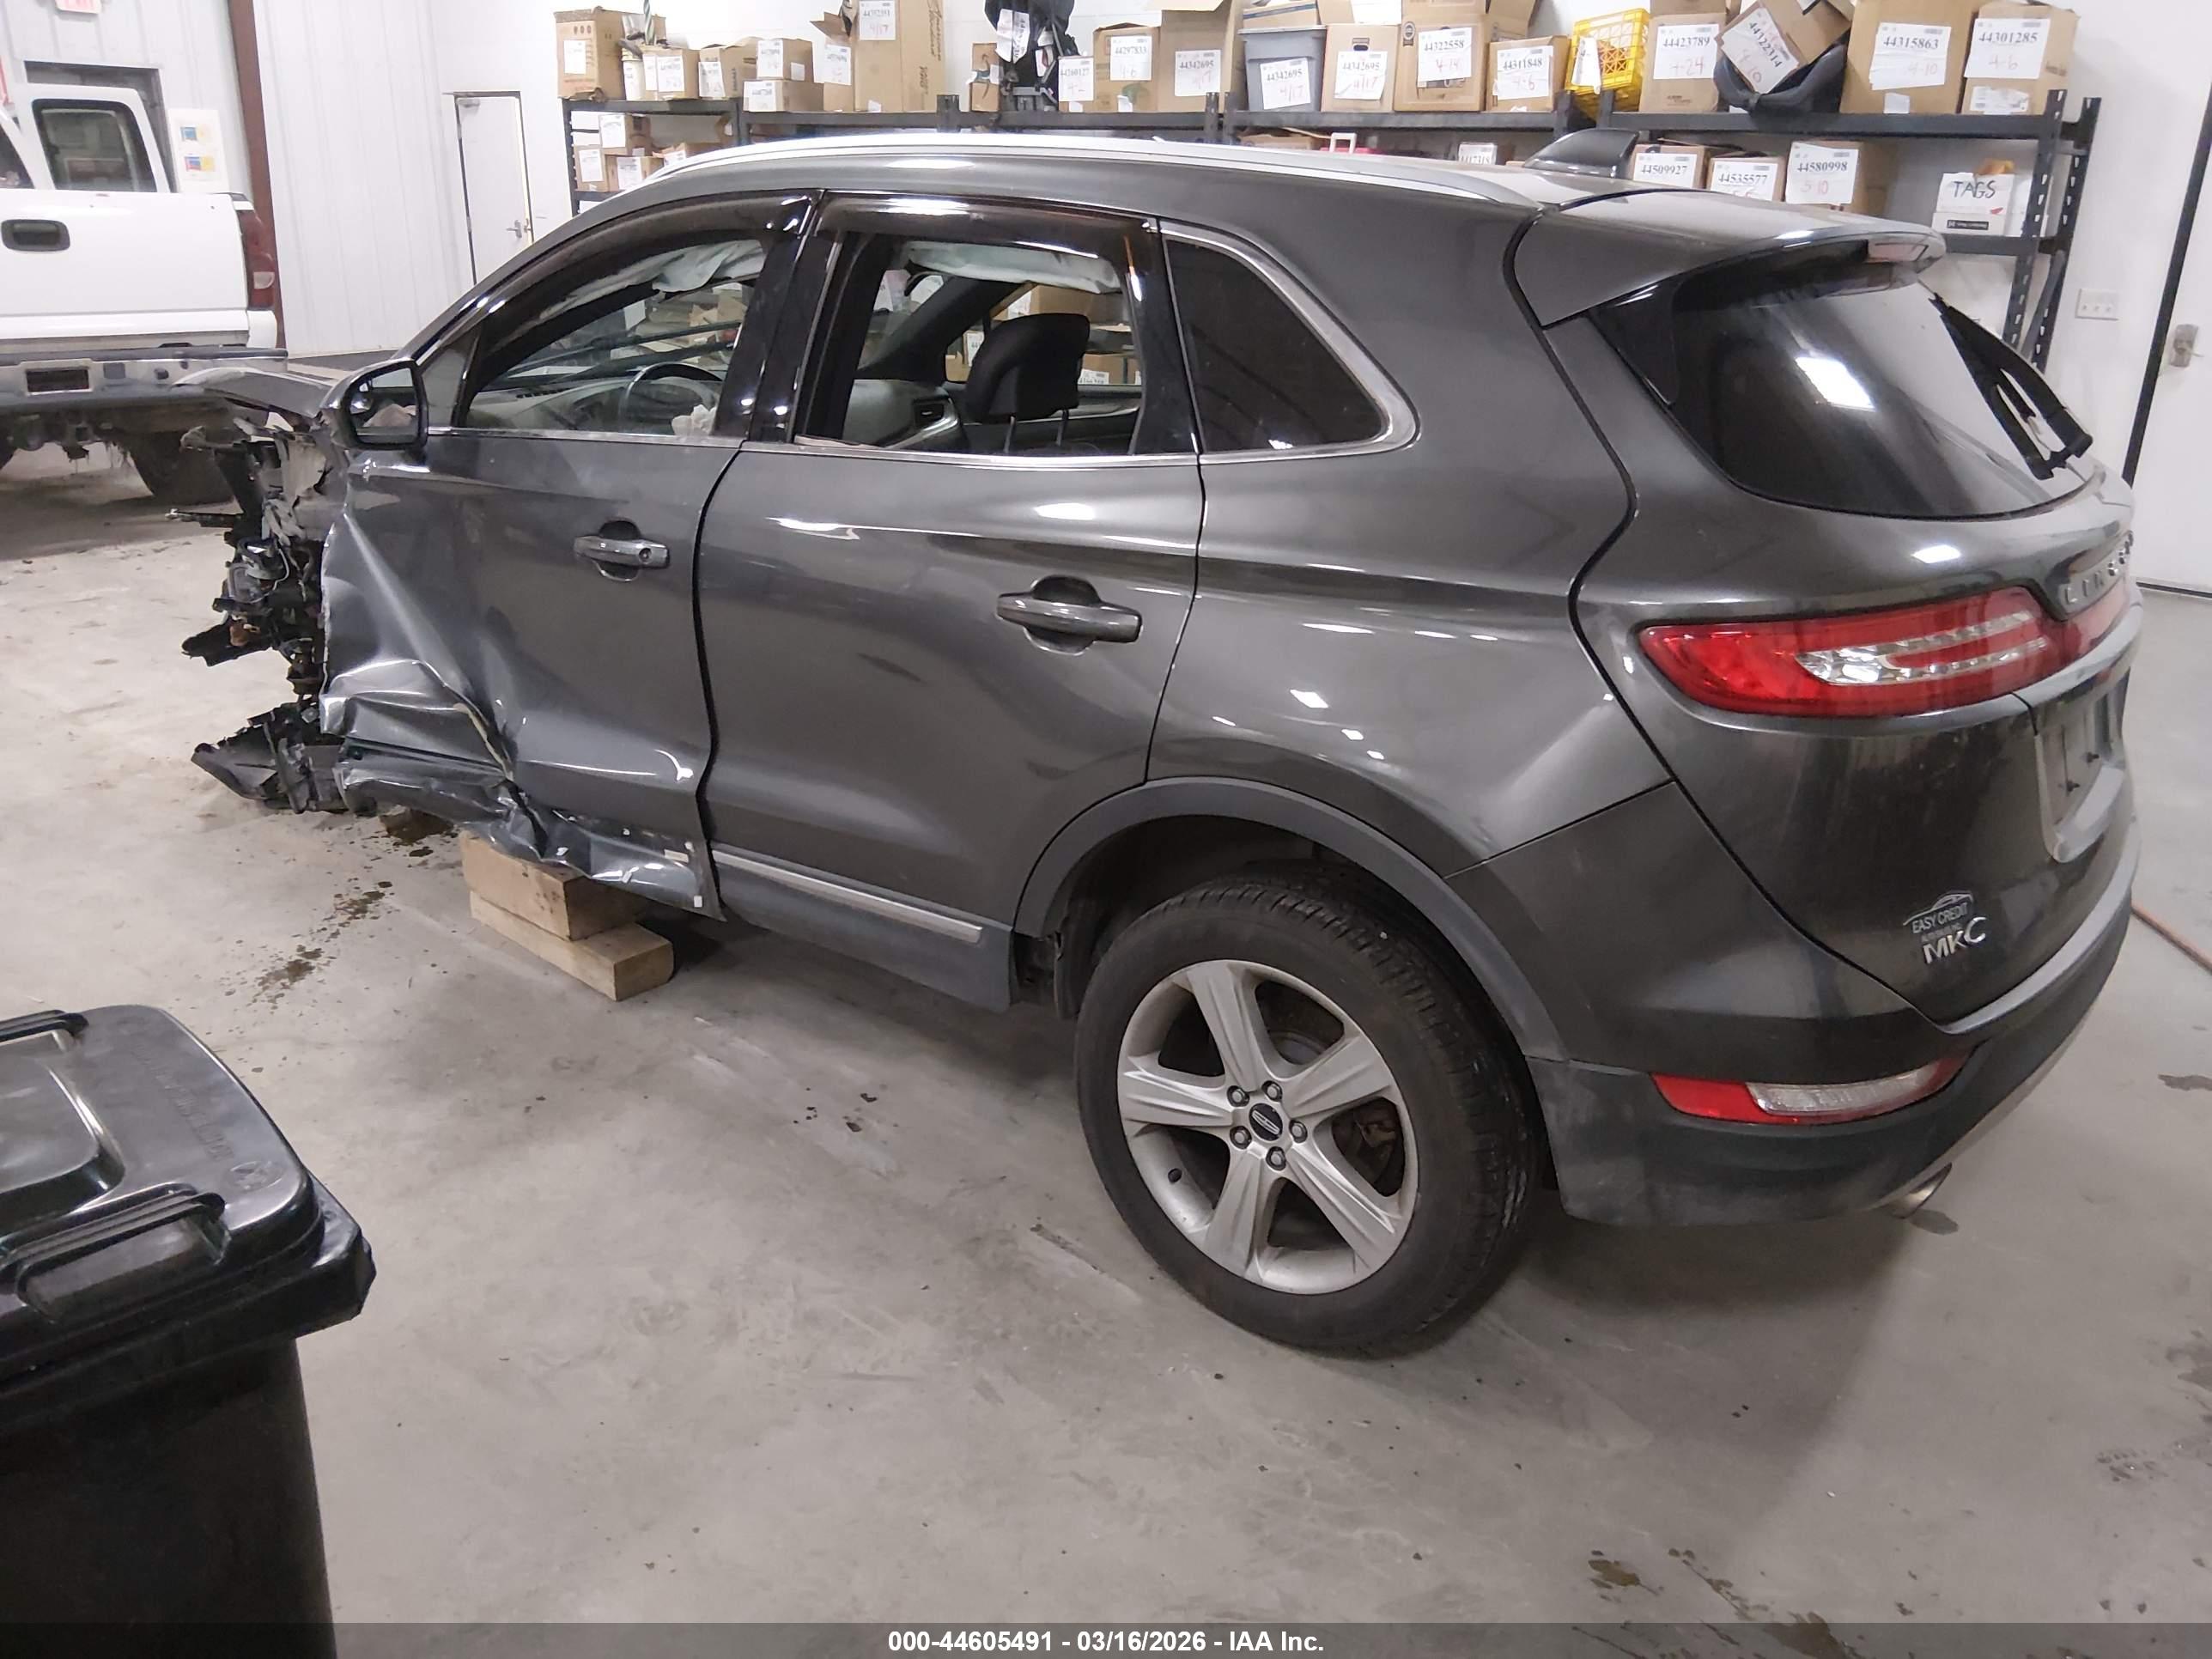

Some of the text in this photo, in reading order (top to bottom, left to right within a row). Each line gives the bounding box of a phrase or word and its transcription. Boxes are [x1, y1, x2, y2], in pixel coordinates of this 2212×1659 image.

[1662, 35, 1711, 48] 44423789
[1882, 35, 1940, 50] 44315863
[1978, 31, 2039, 44] 44301285
[1423, 39, 1465, 52] 44322558
[1179, 59, 1216, 70] 44342695
[1341, 61, 1380, 71] 44342695
[1503, 57, 1543, 70] 44311848
[1266, 68, 1303, 82] 44342695
[1640, 164, 1688, 175] 44509927
[1796, 161, 1848, 173] 44580998
[1717, 173, 1768, 185] 44535577
[1952, 179, 1996, 199] TAGS
[1911, 915, 1937, 934] EASY
[1937, 902, 1968, 925] CREDIT
[1923, 916, 1987, 964] MKC
